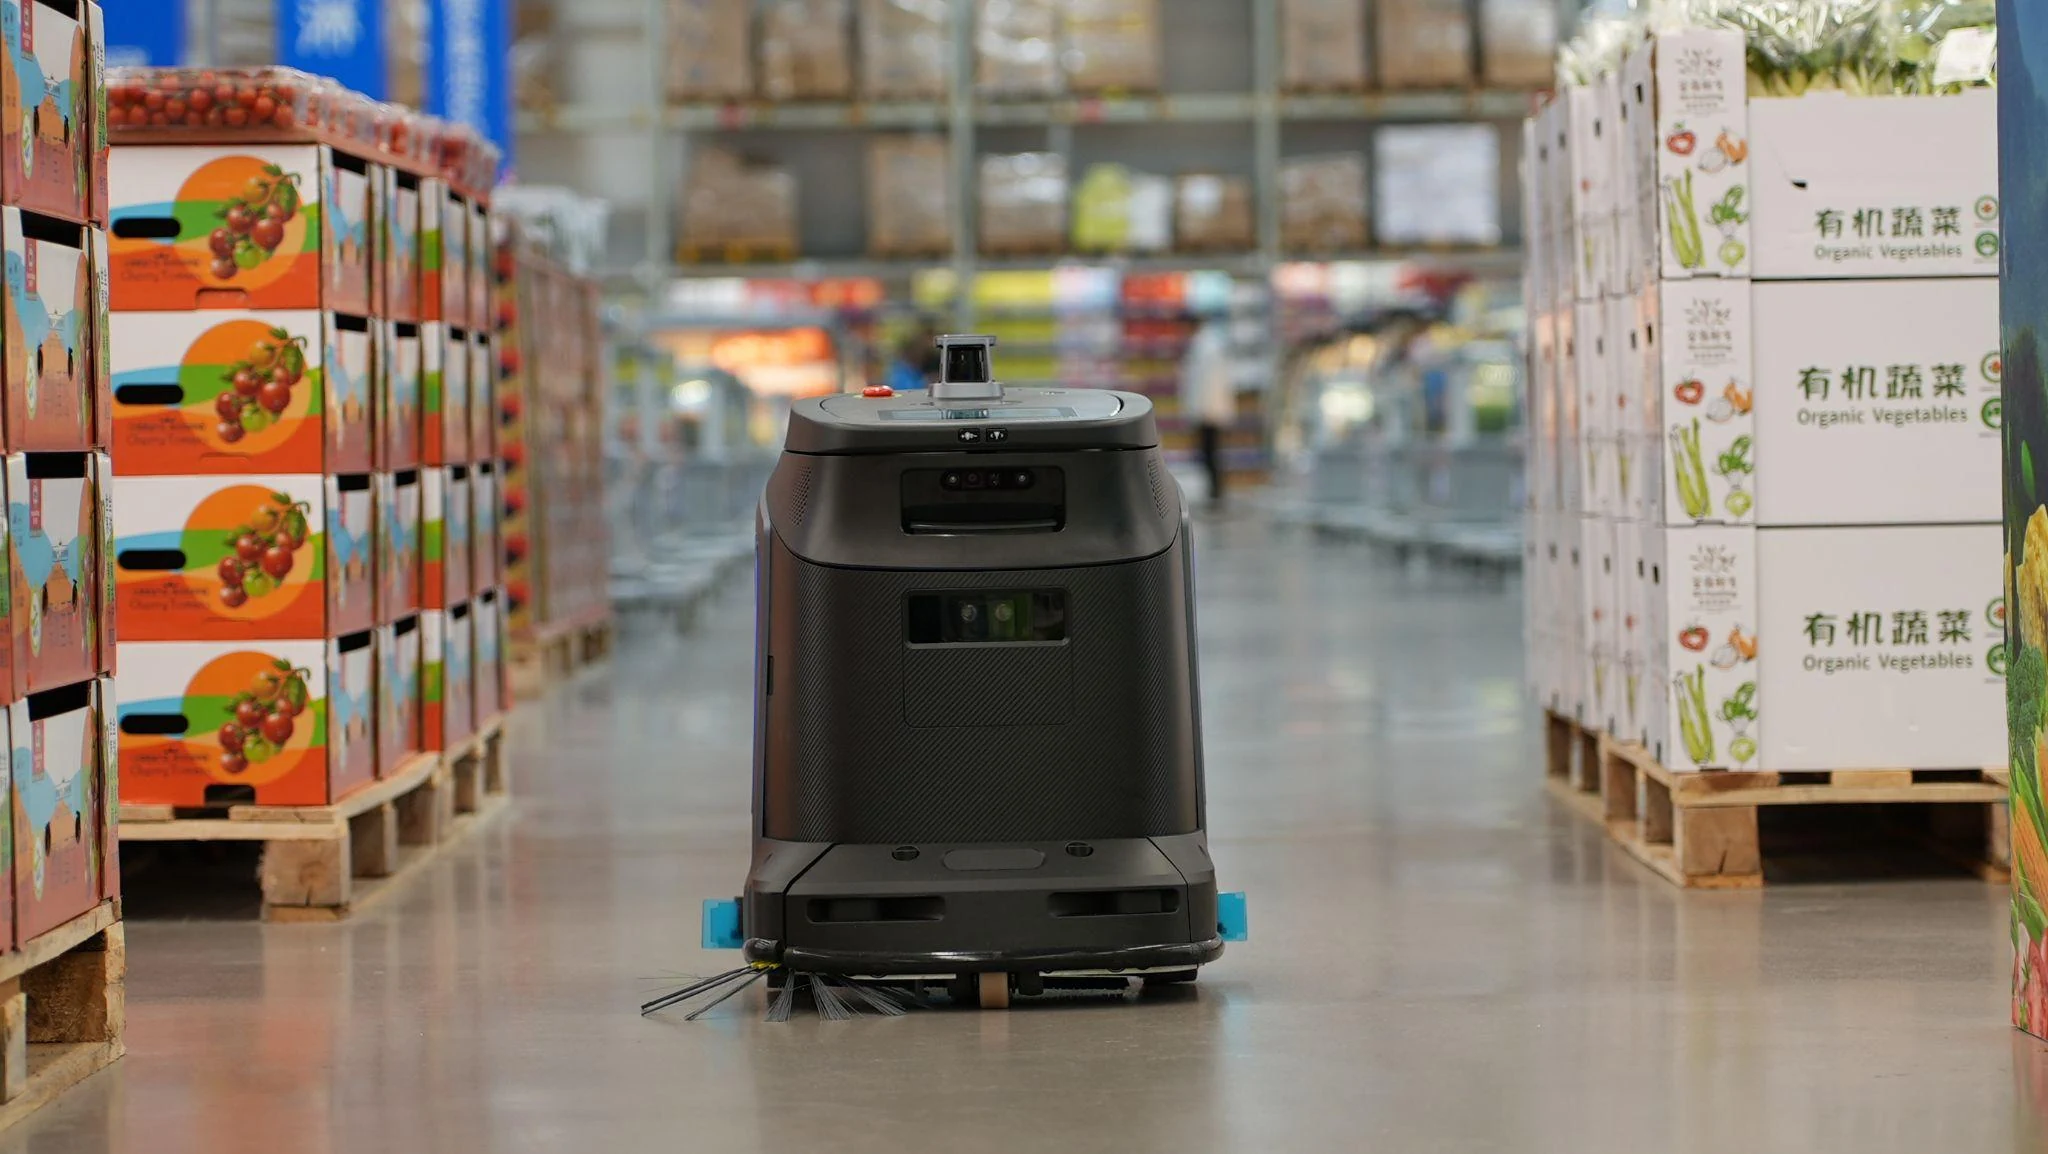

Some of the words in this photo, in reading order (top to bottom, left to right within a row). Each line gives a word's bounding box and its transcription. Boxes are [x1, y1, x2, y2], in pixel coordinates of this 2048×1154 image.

[1814, 206, 1962, 238] 有机蔬菜
[1814, 244, 1872, 262] Organic
[1878, 242, 1963, 261] Vegetables
[1797, 362, 1968, 401] 有机蔬菜
[1797, 406, 1866, 429] Organic
[1872, 404, 1969, 428] Vegetables
[1803, 609, 1973, 648] 有机蔬菜
[1803, 652, 1871, 675] Organic
[1878, 650, 1974, 674] Vegetables
